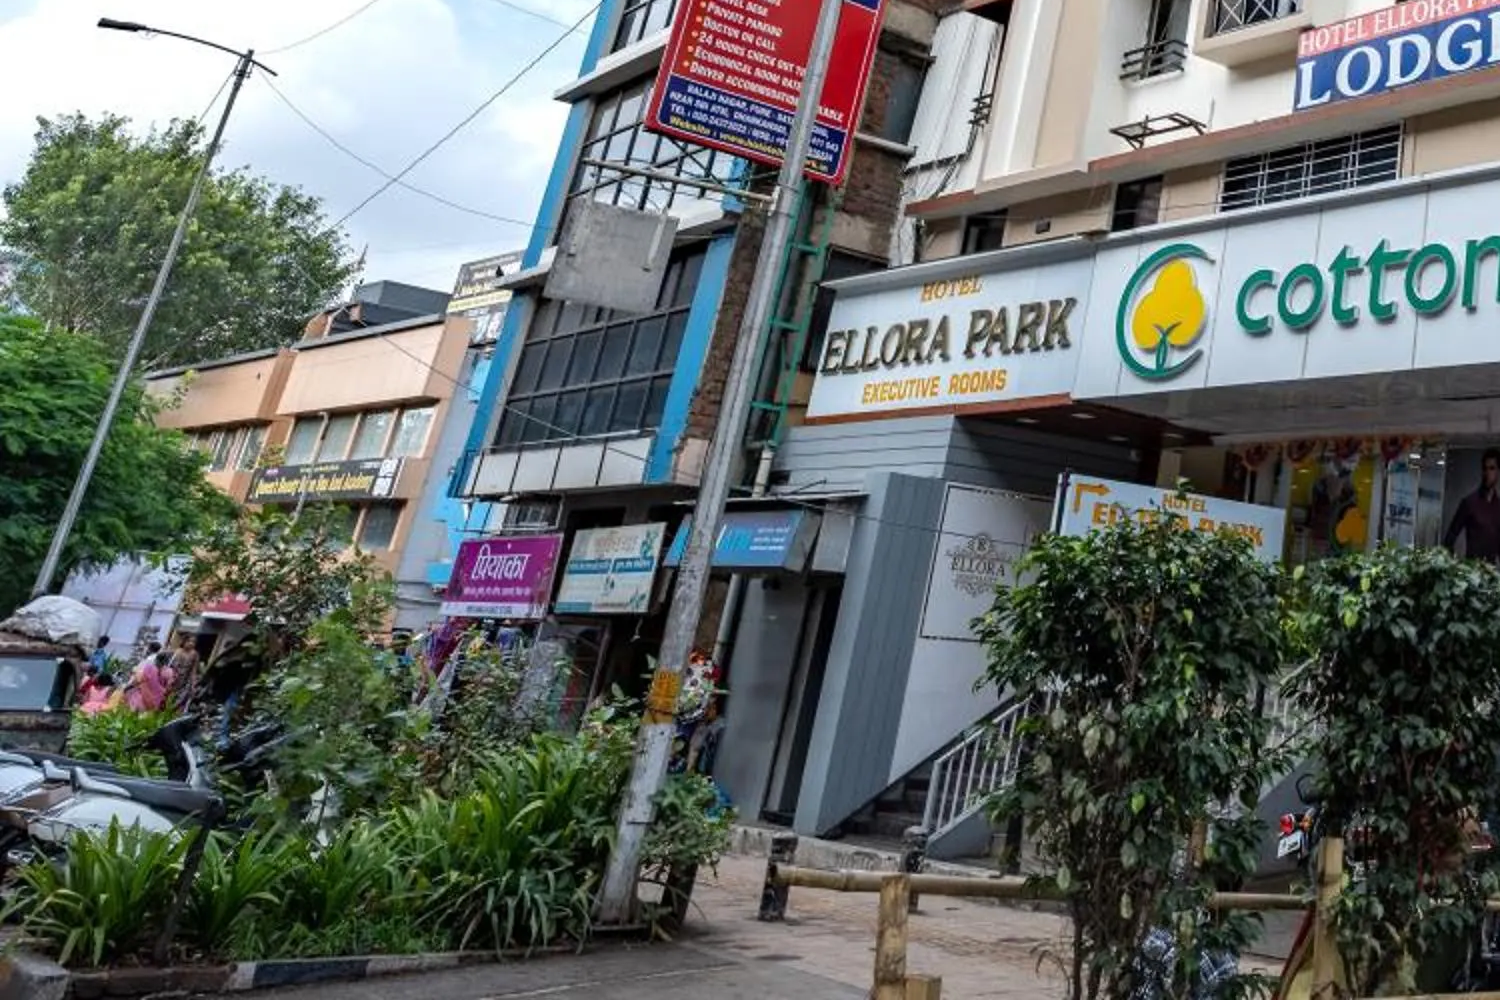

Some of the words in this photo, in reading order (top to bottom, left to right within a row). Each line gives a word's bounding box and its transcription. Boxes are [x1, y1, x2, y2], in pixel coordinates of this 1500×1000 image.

[1300, 20, 1368, 52] HOTEL
[921, 275, 982, 302] HOTEL
[821, 316, 952, 375] ELLORA
[963, 298, 1077, 359] PARK
[863, 376, 941, 404] EXECUTIVE
[948, 369, 1007, 394] ROOMS
